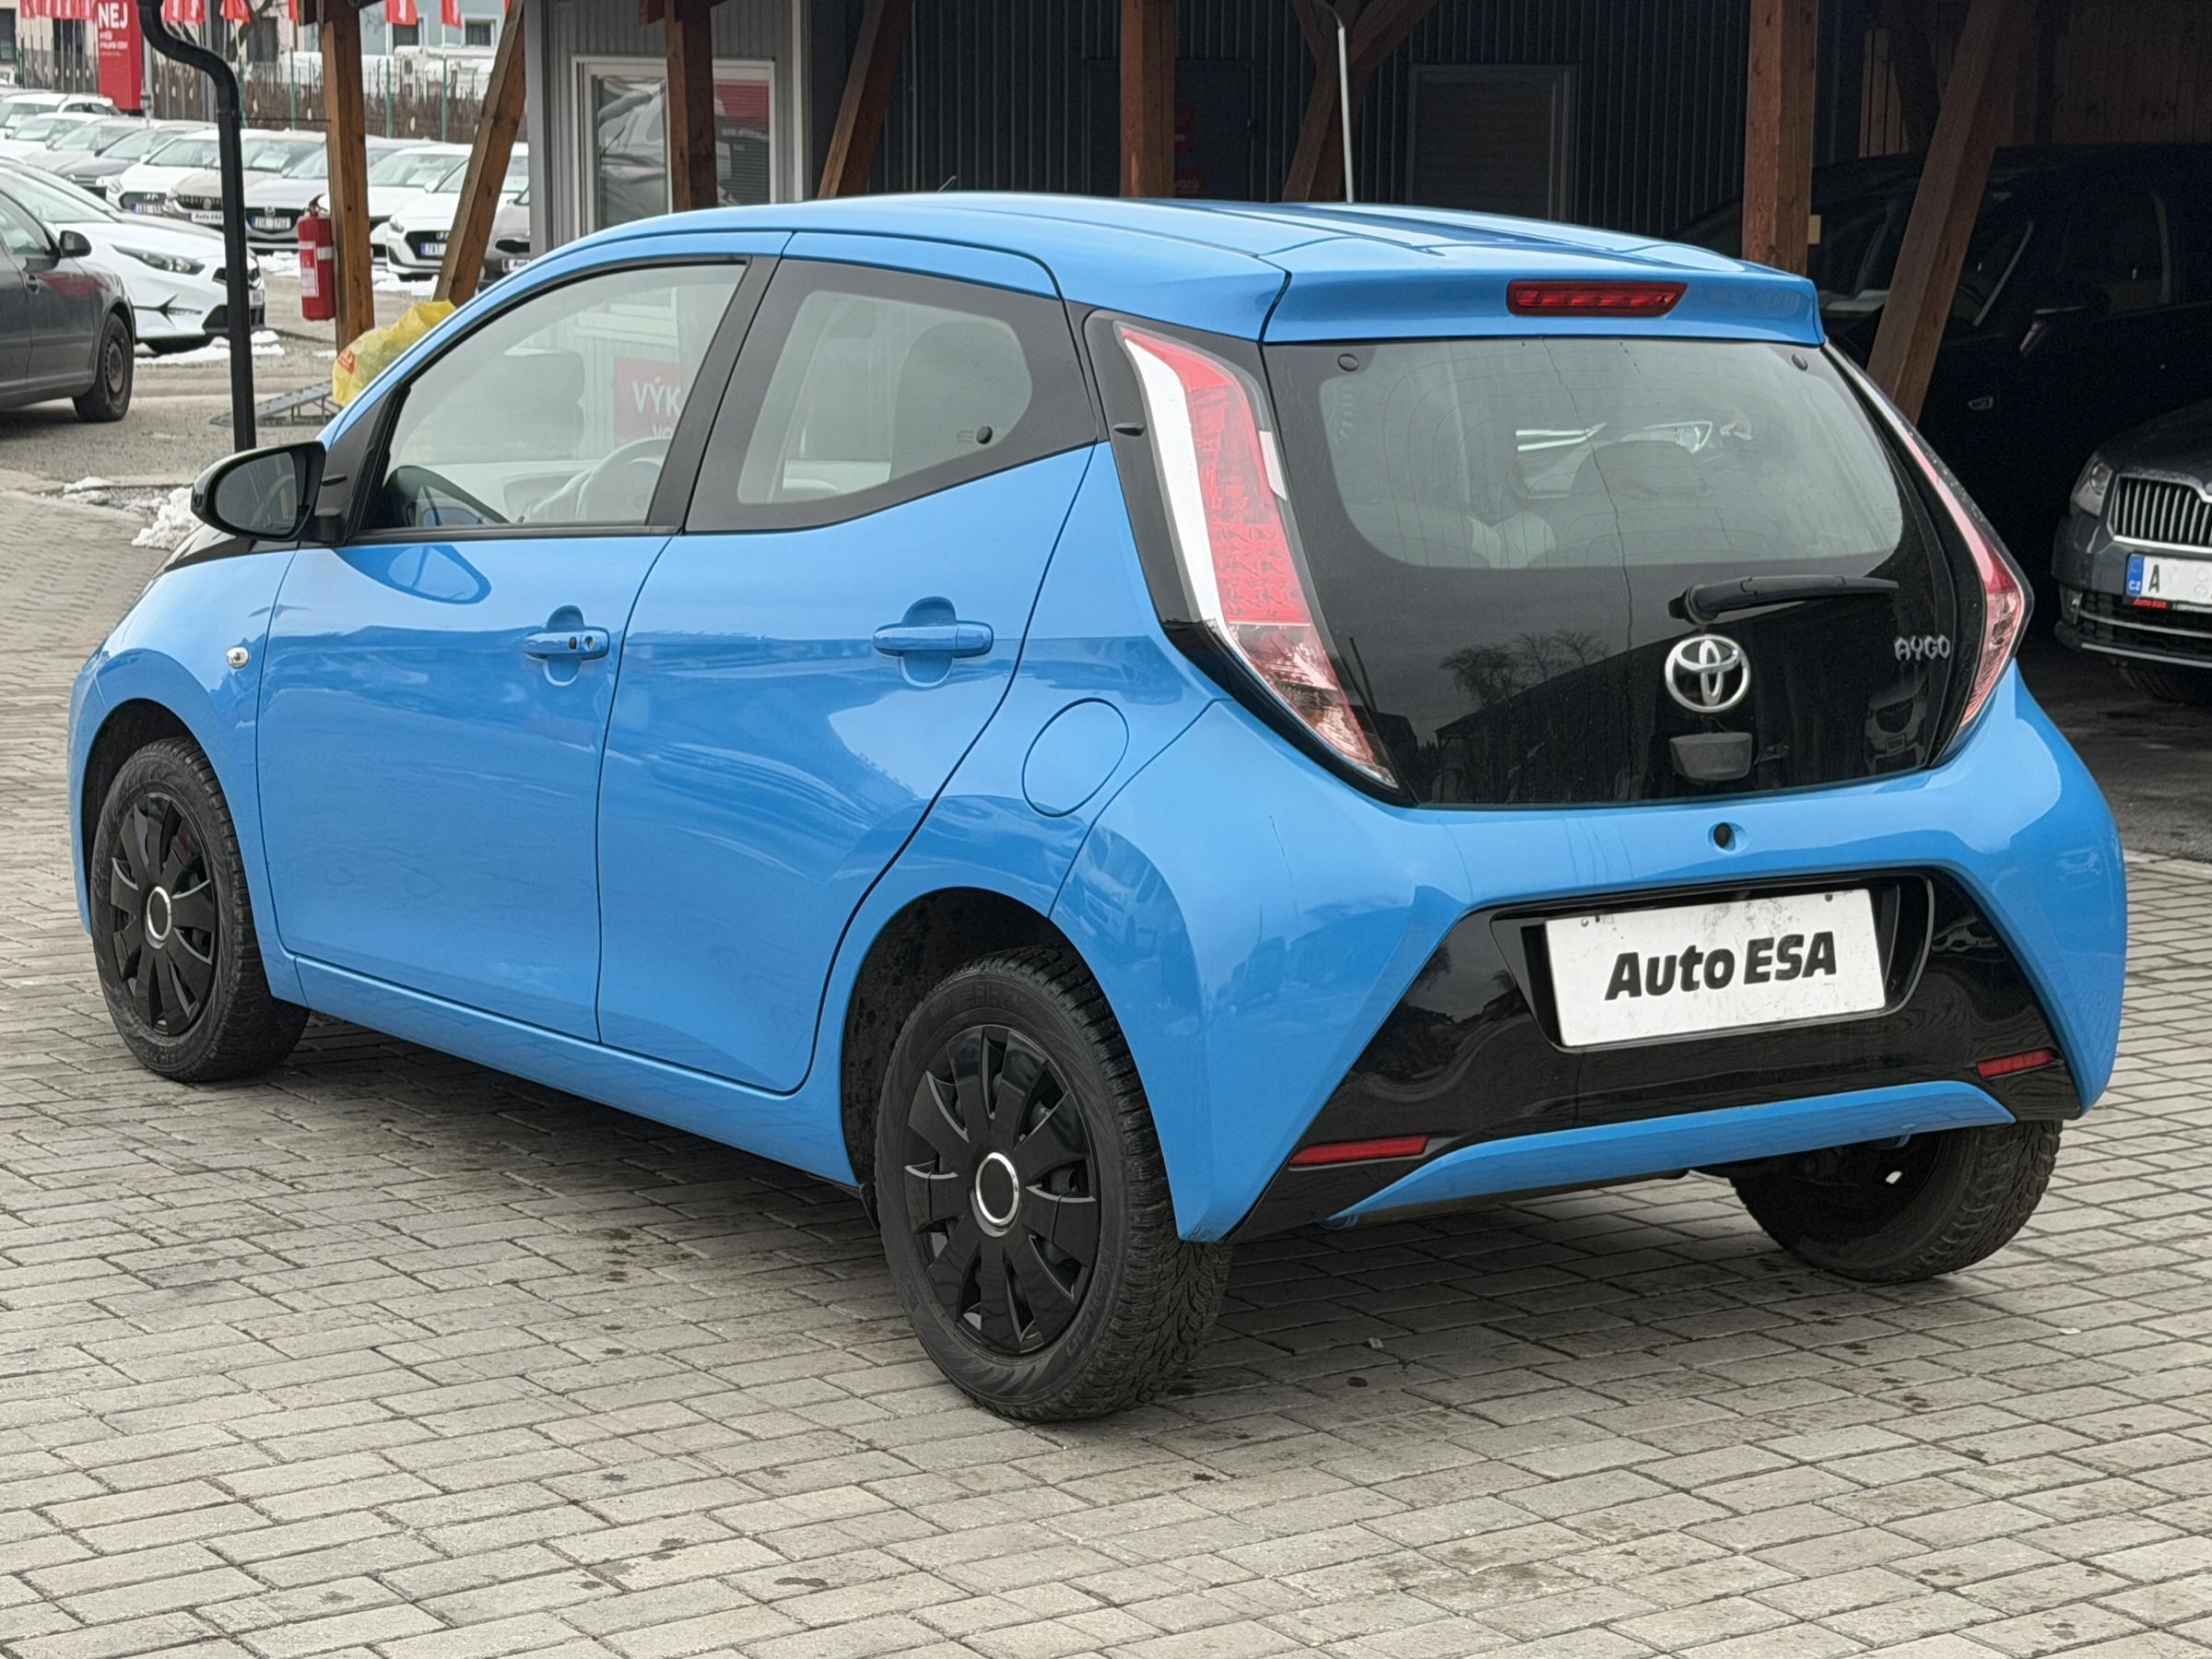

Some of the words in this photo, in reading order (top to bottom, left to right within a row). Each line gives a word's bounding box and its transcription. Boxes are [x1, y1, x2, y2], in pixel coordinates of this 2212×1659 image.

[98, 2, 128, 29] NEJ
[2128, 581, 2141, 591] CZ
[1894, 634, 1951, 661] AYGO
[1604, 944, 1735, 1001] Auto
[1743, 930, 1837, 985] ESA
